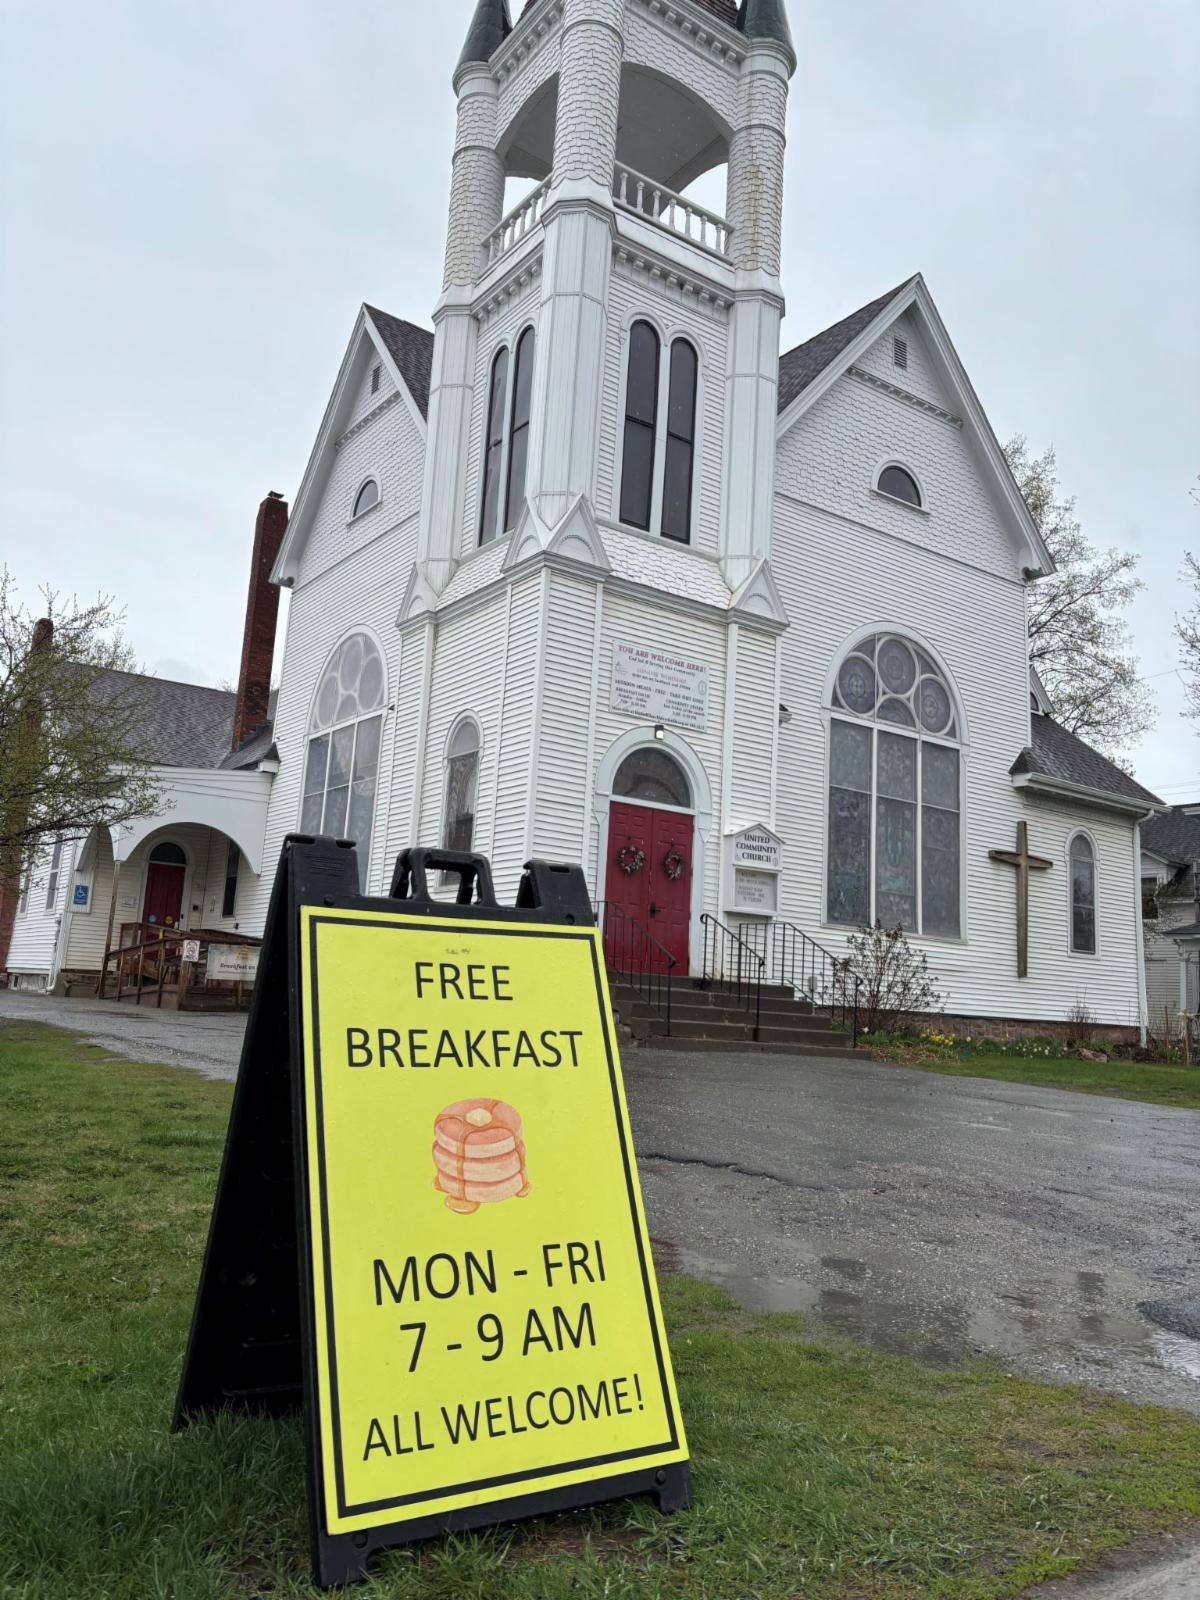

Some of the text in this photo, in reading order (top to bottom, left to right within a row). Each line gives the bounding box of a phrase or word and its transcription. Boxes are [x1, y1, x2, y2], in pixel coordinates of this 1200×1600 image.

[619, 645, 633, 654] YOU
[651, 653, 685, 668] WELCOME
[736, 842, 777, 853] COMMUNITY
[742, 852, 771, 862] CHURCH
[745, 834, 770, 843] UNITED
[414, 961, 513, 1001] FREE
[346, 1027, 583, 1068] BREAKFAST
[372, 1249, 497, 1306] MON
[542, 1239, 606, 1287] FRI
[522, 1302, 596, 1356] AM
[362, 1373, 645, 1461] ALL WELCOME!
